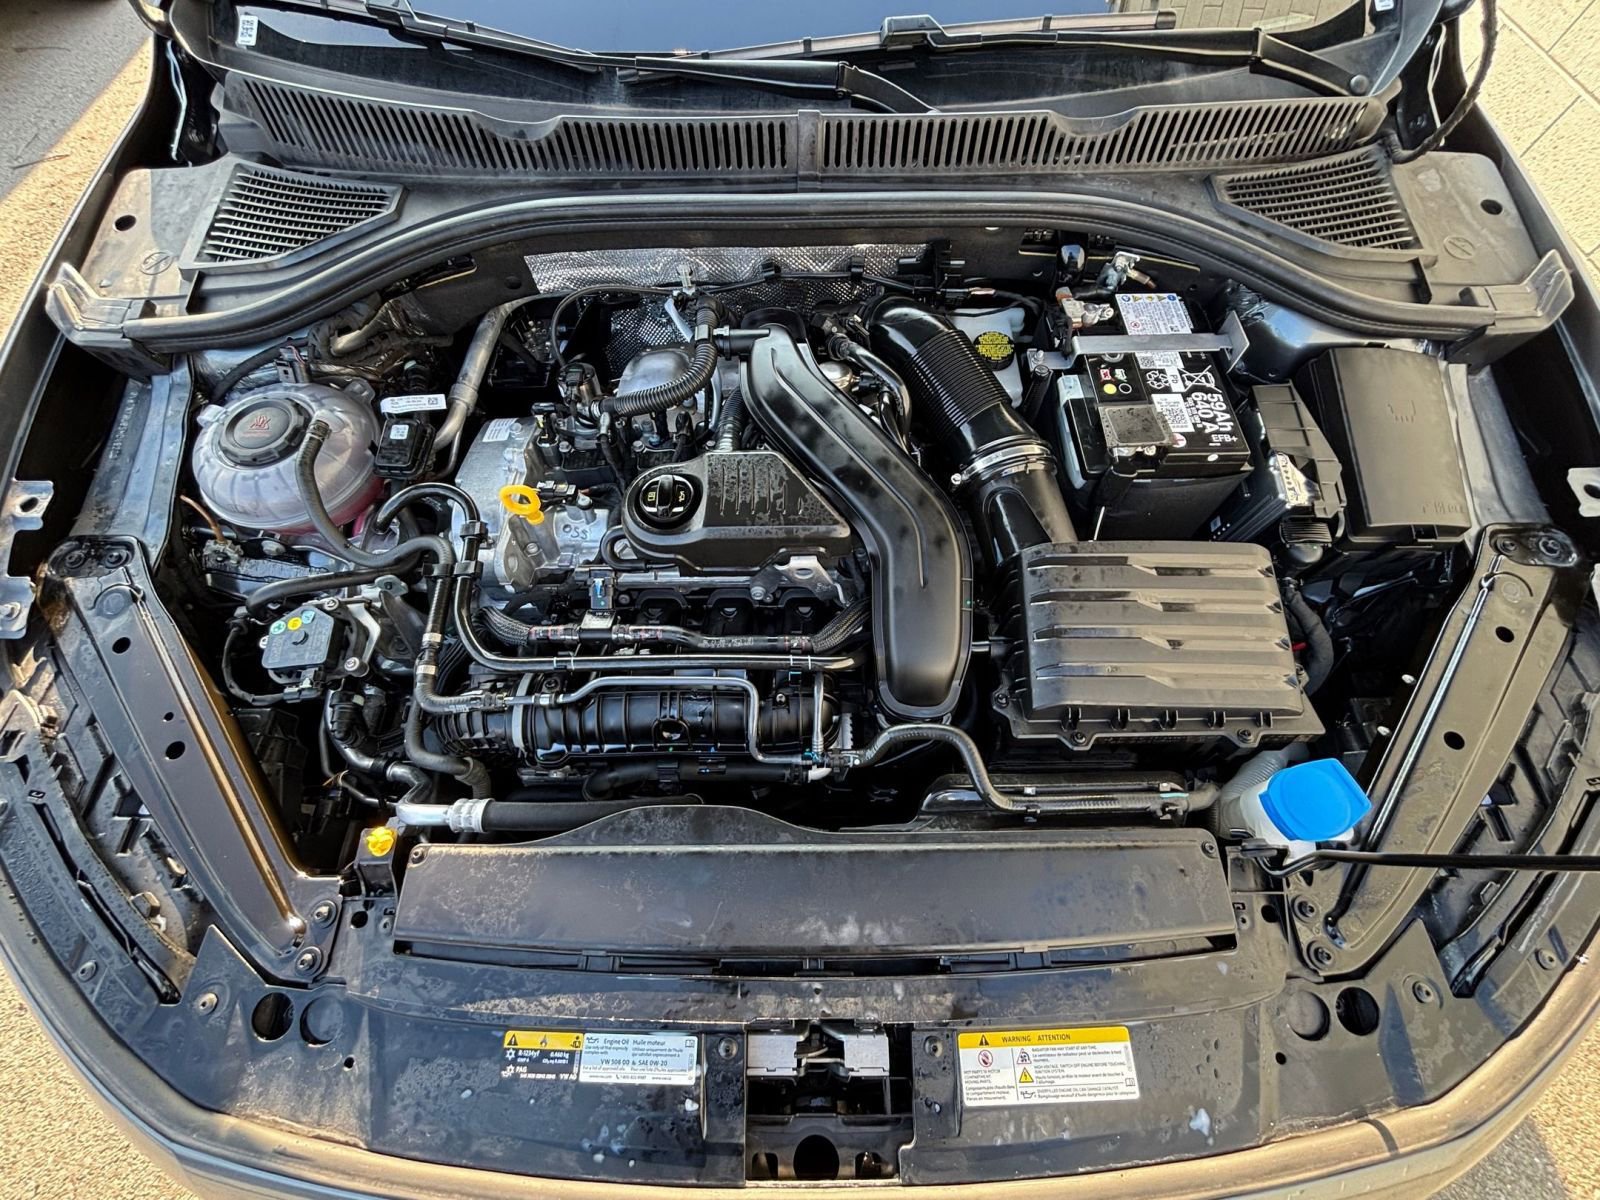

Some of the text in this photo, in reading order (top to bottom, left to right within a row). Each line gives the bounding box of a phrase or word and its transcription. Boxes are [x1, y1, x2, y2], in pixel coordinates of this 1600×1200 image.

[1191, 392, 1215, 419] 640
[1207, 393, 1234, 432] 59Ah
[1202, 420, 1220, 434] A
[1211, 434, 1238, 443] EFB+
[1002, 1033, 1071, 1042] WARNING ATTENTION
